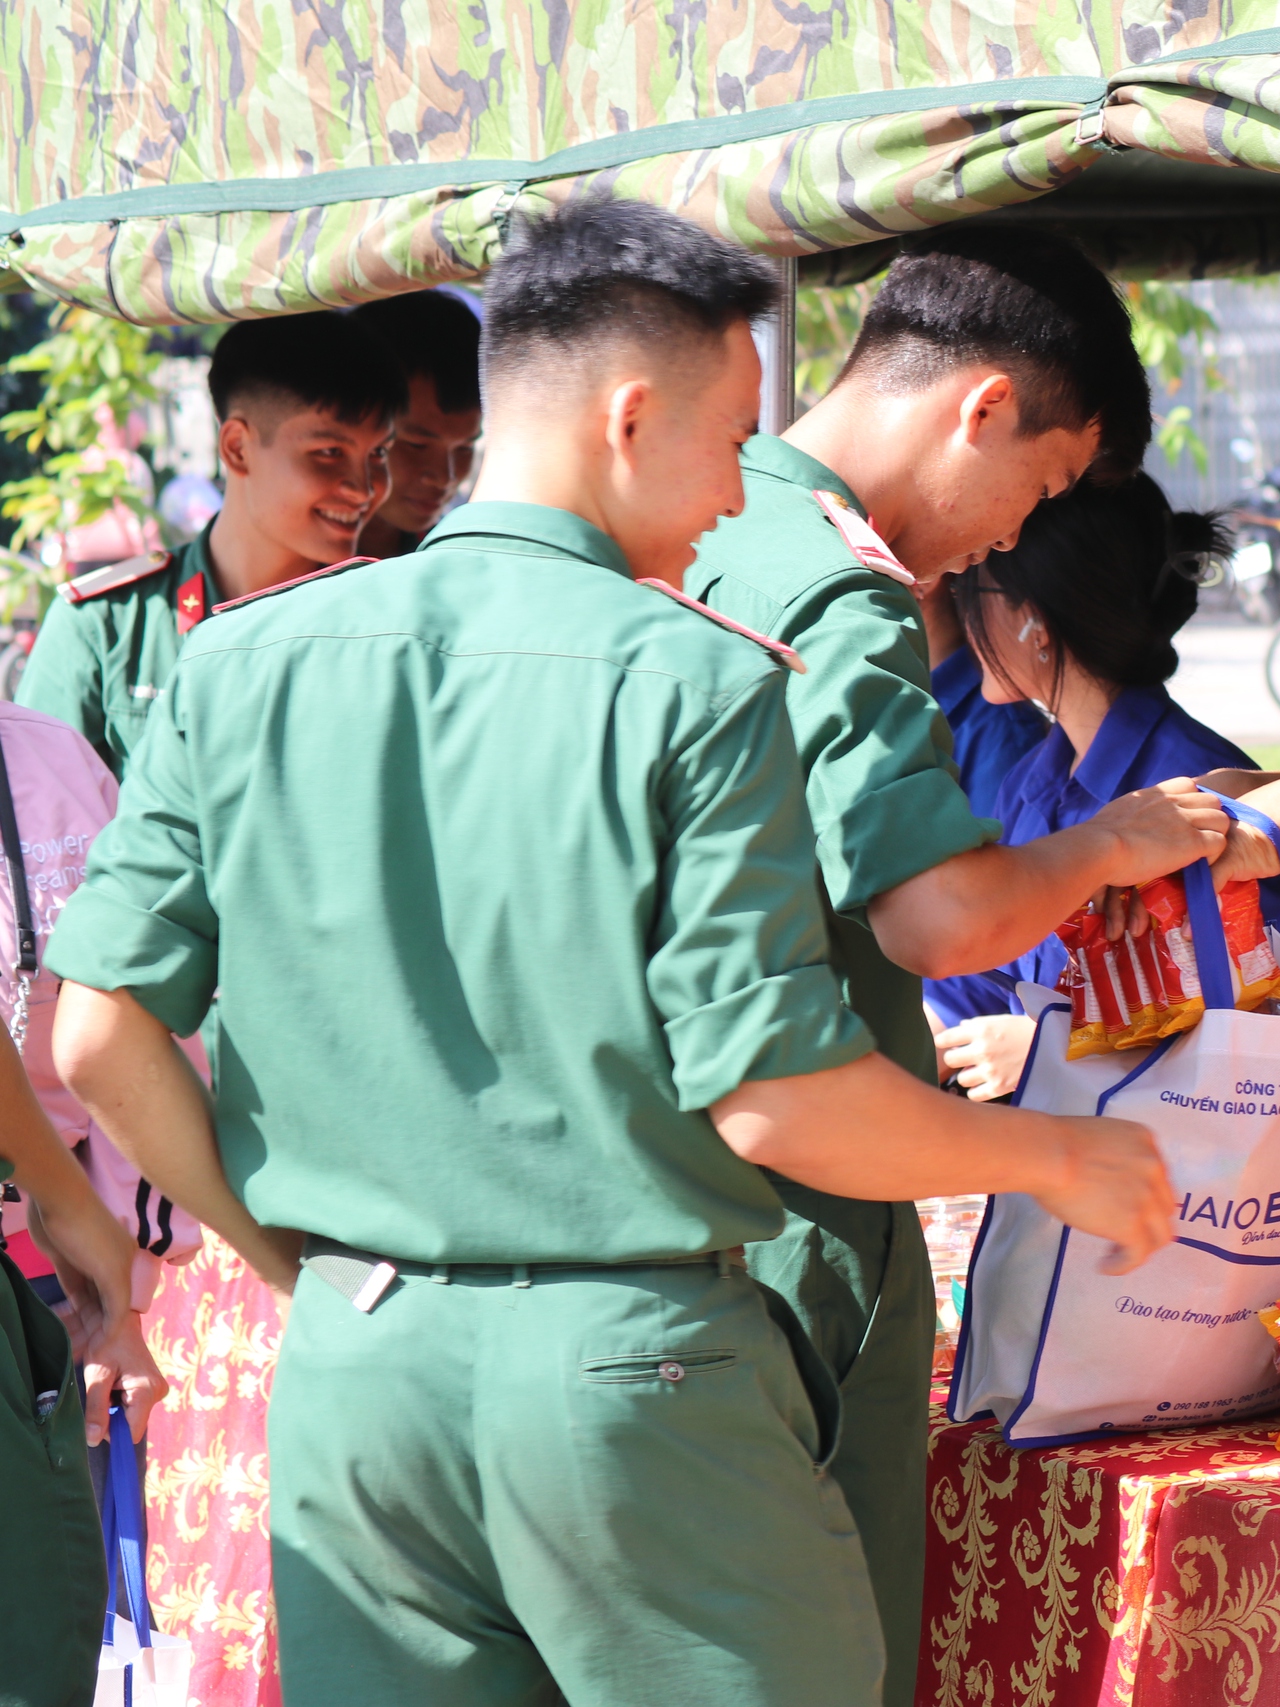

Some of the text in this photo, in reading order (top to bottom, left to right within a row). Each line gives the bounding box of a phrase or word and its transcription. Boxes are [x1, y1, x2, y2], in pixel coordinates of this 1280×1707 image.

[20, 834, 88, 864] Power
[1236, 1079, 1274, 1096] CÔNG
[1223, 1101, 1256, 1115] GIAO
[1115, 1296, 1152, 1318] Đào
[1156, 1304, 1180, 1322] tạo
[1182, 1309, 1222, 1328] trong
[1173, 1402, 1192, 1410] 090
[1194, 1401, 1210, 1409] 188
[1212, 1398, 1233, 1408] 1963
